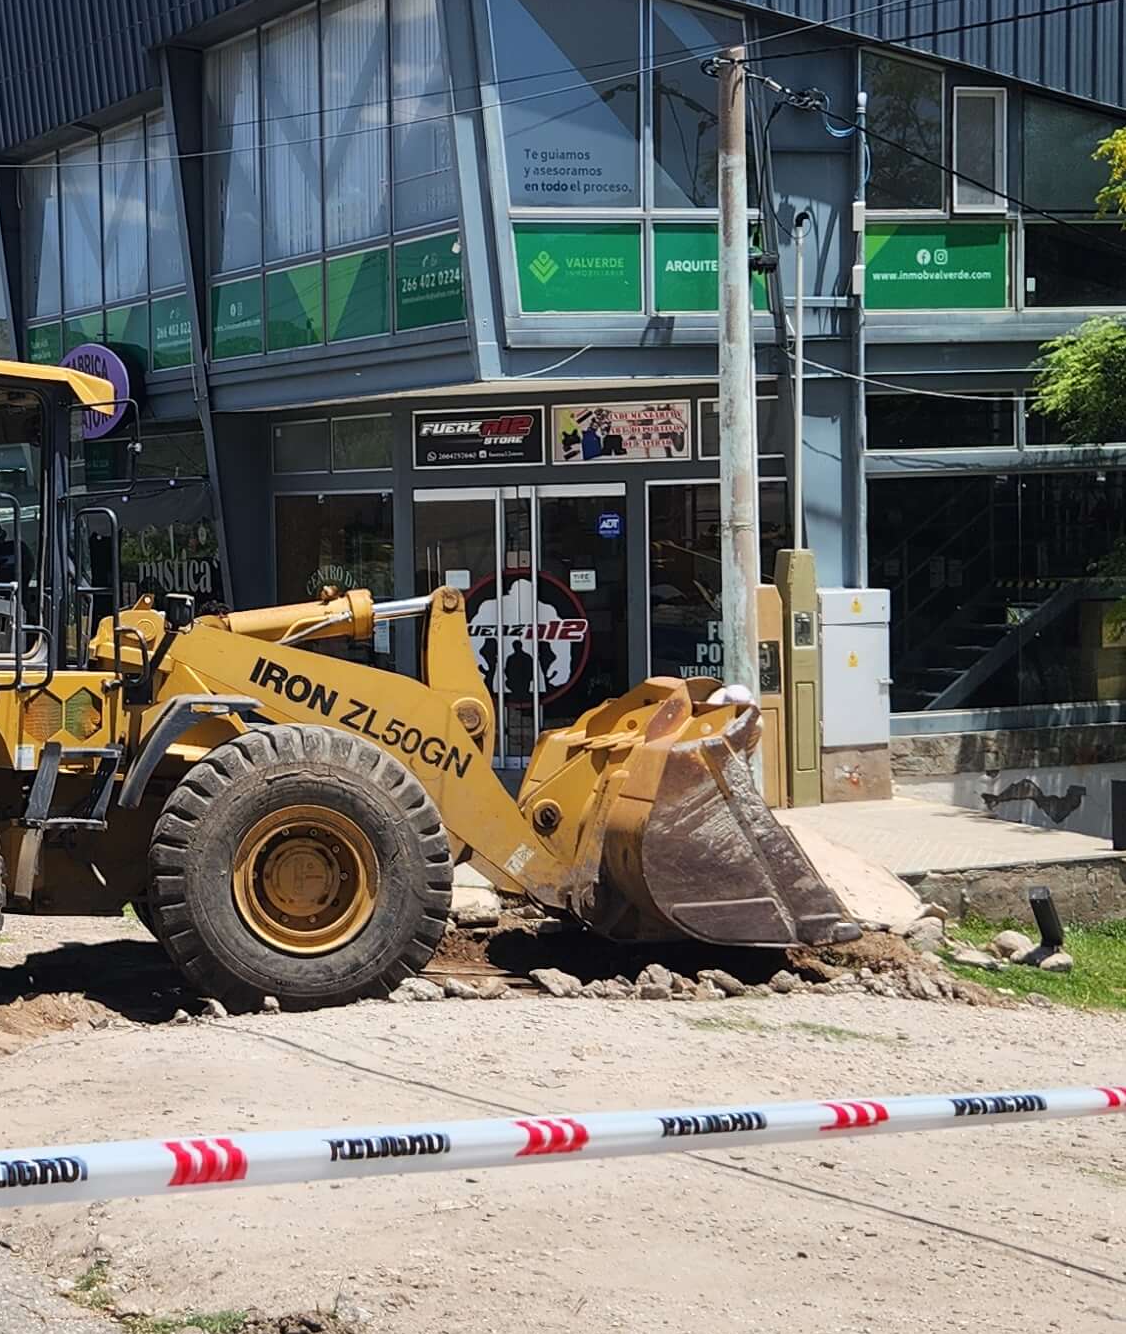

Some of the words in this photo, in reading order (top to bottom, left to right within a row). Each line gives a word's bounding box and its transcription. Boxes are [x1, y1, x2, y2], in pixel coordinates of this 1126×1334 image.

[524, 149, 538, 160] Te
[541, 149, 590, 162] guiamos
[524, 167, 531, 178] y
[534, 166, 602, 176] asesoramos
[542, 181, 567, 192] todo
[570, 181, 580, 192] el
[566, 258, 625, 268] VALVERDE
[665, 260, 719, 273] ARQUITE
[402, 278, 418, 293] 266
[420, 272, 436, 288] 402
[437, 267, 460, 285] 0224
[872, 269, 992, 281] www.inmobvalverde.com
[66, 354, 108, 379] ABRICA
[483, 436, 524, 445] STORE
[600, 519, 619, 529] ADT
[307, 565, 343, 596] CENTRO
[696, 643, 722, 663] PO
[680, 666, 722, 678] VELOCI
[250, 658, 337, 716] IRON
[338, 698, 472, 779] ZL50GN
